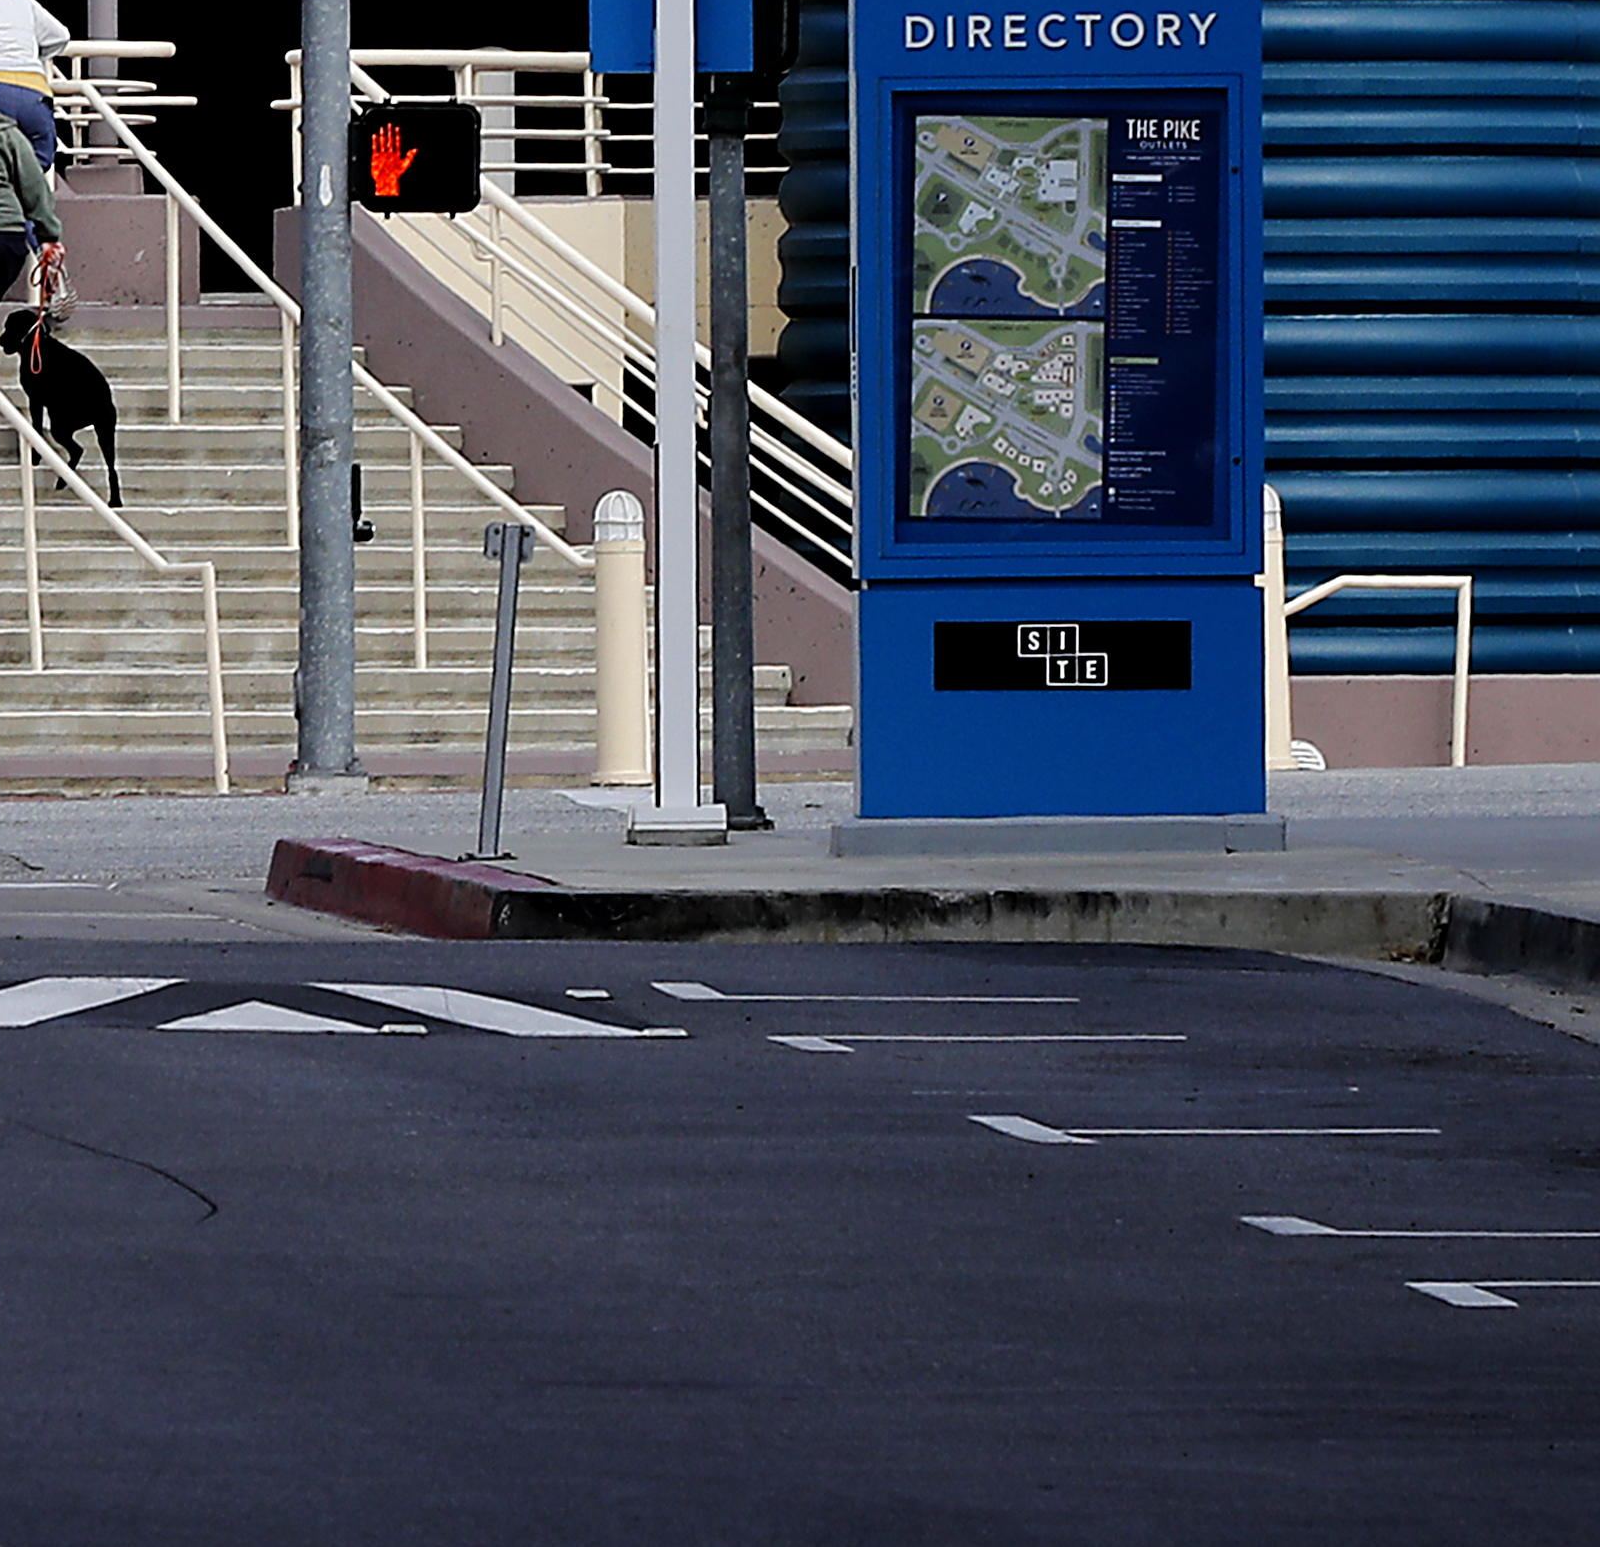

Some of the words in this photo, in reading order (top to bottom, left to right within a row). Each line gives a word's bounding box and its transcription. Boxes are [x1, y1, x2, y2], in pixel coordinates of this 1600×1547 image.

[904, 12, 1218, 49] DIRECTORY
[1125, 118, 1159, 141] THE
[1163, 118, 1202, 141] PIKE
[1139, 140, 1188, 150] OUTLETS
